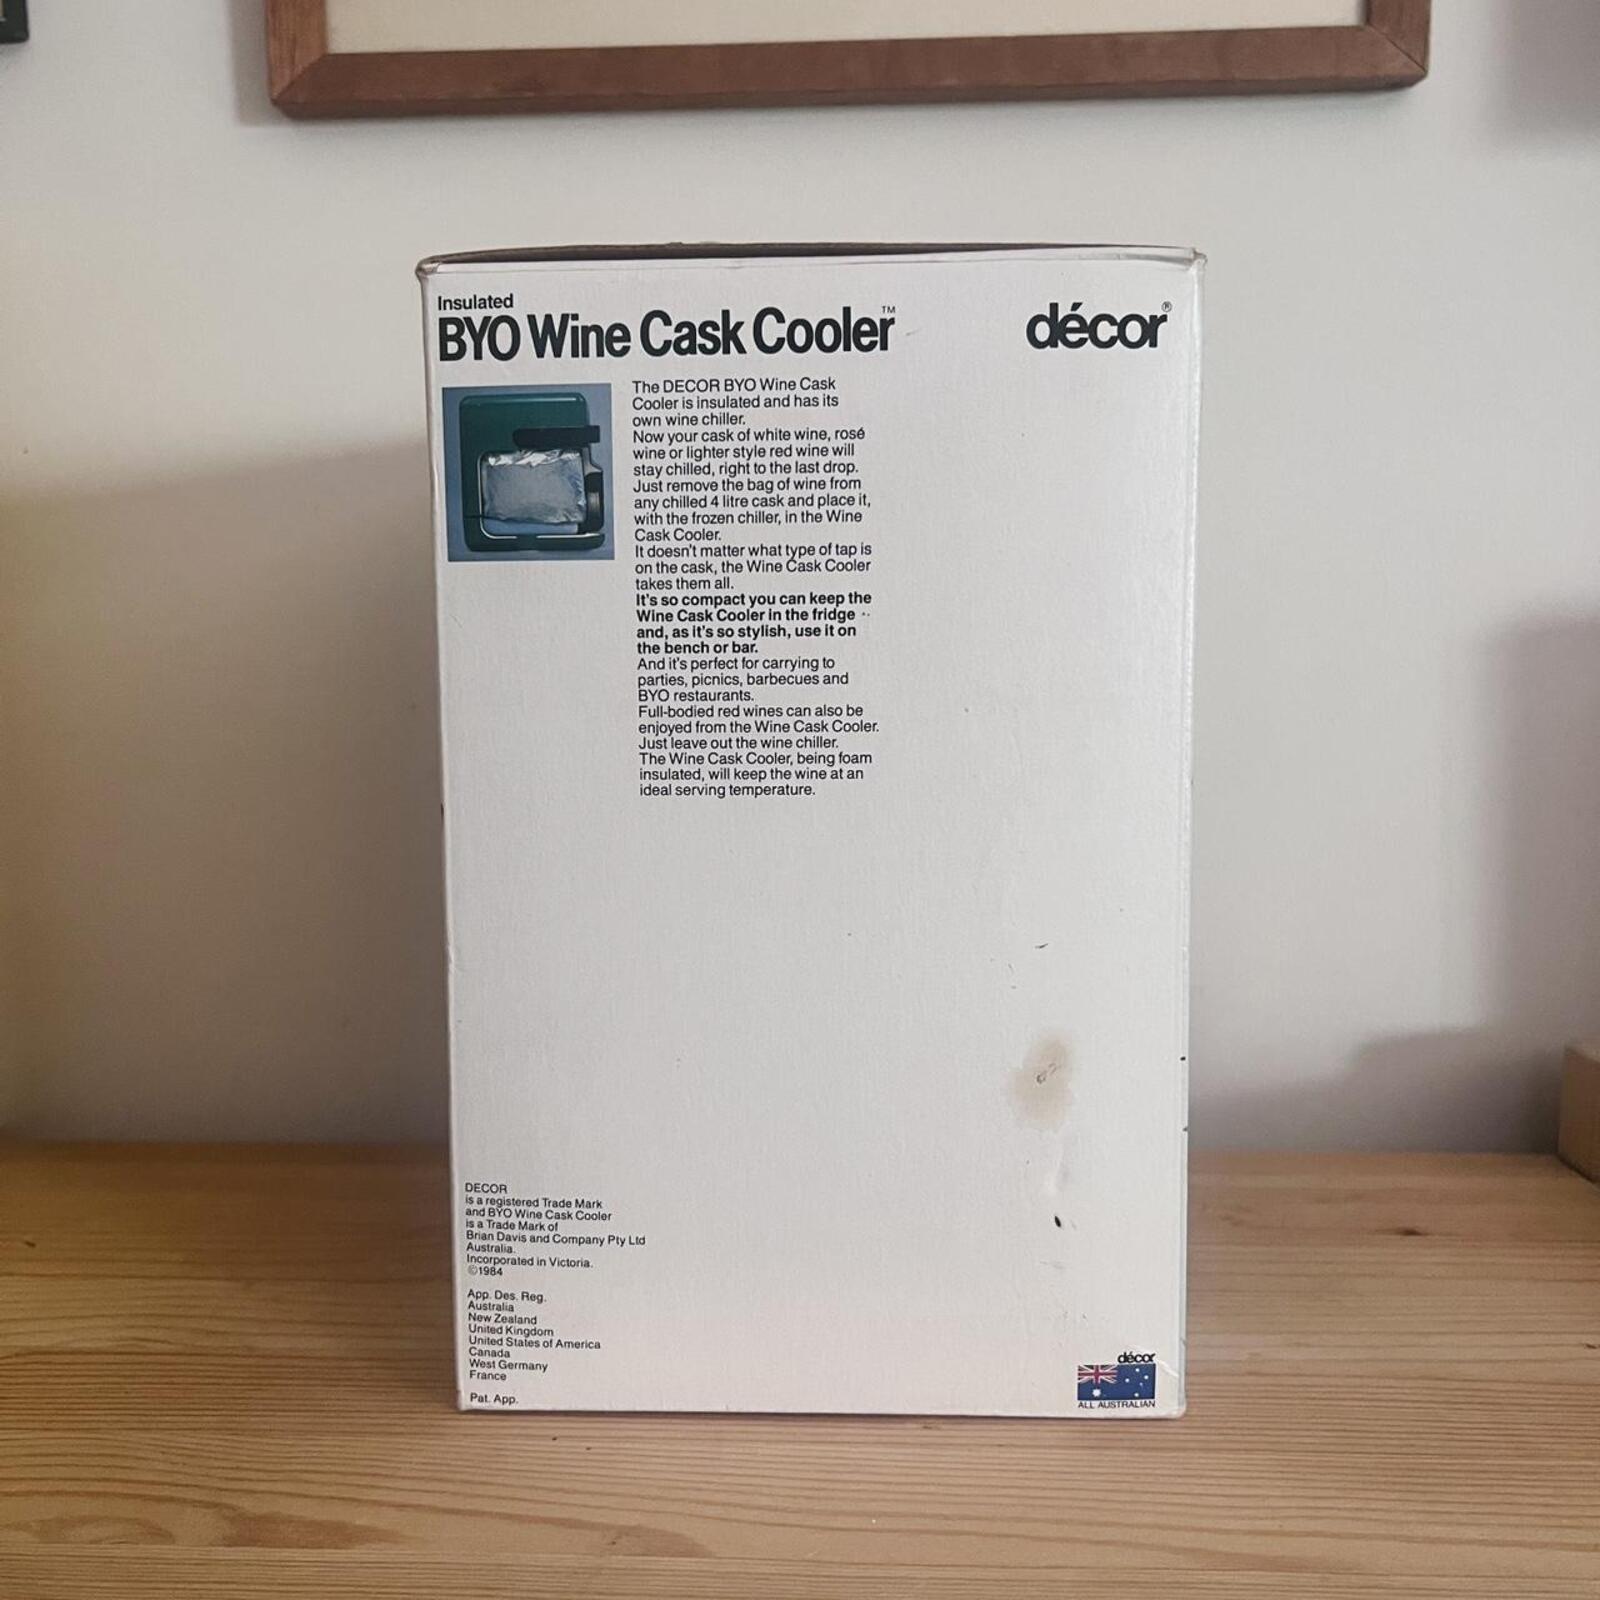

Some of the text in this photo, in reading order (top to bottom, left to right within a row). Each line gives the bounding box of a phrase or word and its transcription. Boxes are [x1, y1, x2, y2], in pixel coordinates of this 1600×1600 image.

[438, 293, 514, 311] Insulated
[438, 315, 521, 361] BYO
[527, 313, 631, 358] Wine
[640, 309, 747, 356] Cask
[631, 376, 836, 393] The DECOR BYO Wine Cask
[631, 393, 839, 410] Cooler is insulated and has its
[632, 411, 745, 426] own wine chiller.
[633, 426, 865, 446] Now your cask of white wine, rosé
[633, 460, 858, 479] stay chilled, right to the last drop.
[632, 476, 861, 494] Just remove the bag of wine from
[634, 527, 721, 541] Cask Cooler.
[634, 558, 871, 574] on the cask, the Wine Cask Cooler
[635, 576, 734, 590] takes them all.
[636, 591, 872, 608] It's so compact you can keep the
[636, 608, 855, 624] Wine Cask Cooler in the fridge
[636, 640, 758, 654] the bench or bar.
[636, 656, 835, 672] And it's perfect for carrying to
[637, 671, 849, 689] parties, picnics, barbecues and
[638, 688, 754, 702] BYO restaurants.
[638, 703, 863, 718] Full-bodied red wines can also be
[638, 719, 879, 736] enjoyed from the Wine Cask Cooler.
[638, 735, 839, 749] Just leave out the wine chiller.
[638, 751, 872, 767] The Wine Cask Cooler, being foam
[639, 782, 815, 799] ideal serving temperature.
[465, 1183, 507, 1194] DECOR
[465, 1207, 612, 1221] and BYO Wine Cask Cooler
[465, 1219, 558, 1231] is a Trade Mark of
[465, 1230, 645, 1246] Brian Davis and Company Pty Ltd
[465, 1242, 515, 1254] Australia.
[466, 1254, 593, 1268] Incorporated in Victoria.
[520, 1291, 546, 1304] Reg.
[467, 1301, 514, 1312] Australia
[467, 1312, 537, 1325] New Zealand
[468, 1324, 554, 1339] United Kingdom
[468, 1335, 601, 1349] United States of America
[1117, 1351, 1156, 1363] décor
[469, 1359, 548, 1373] West Germany
[1078, 1400, 1156, 1409] ALL AUSTRALIAN
